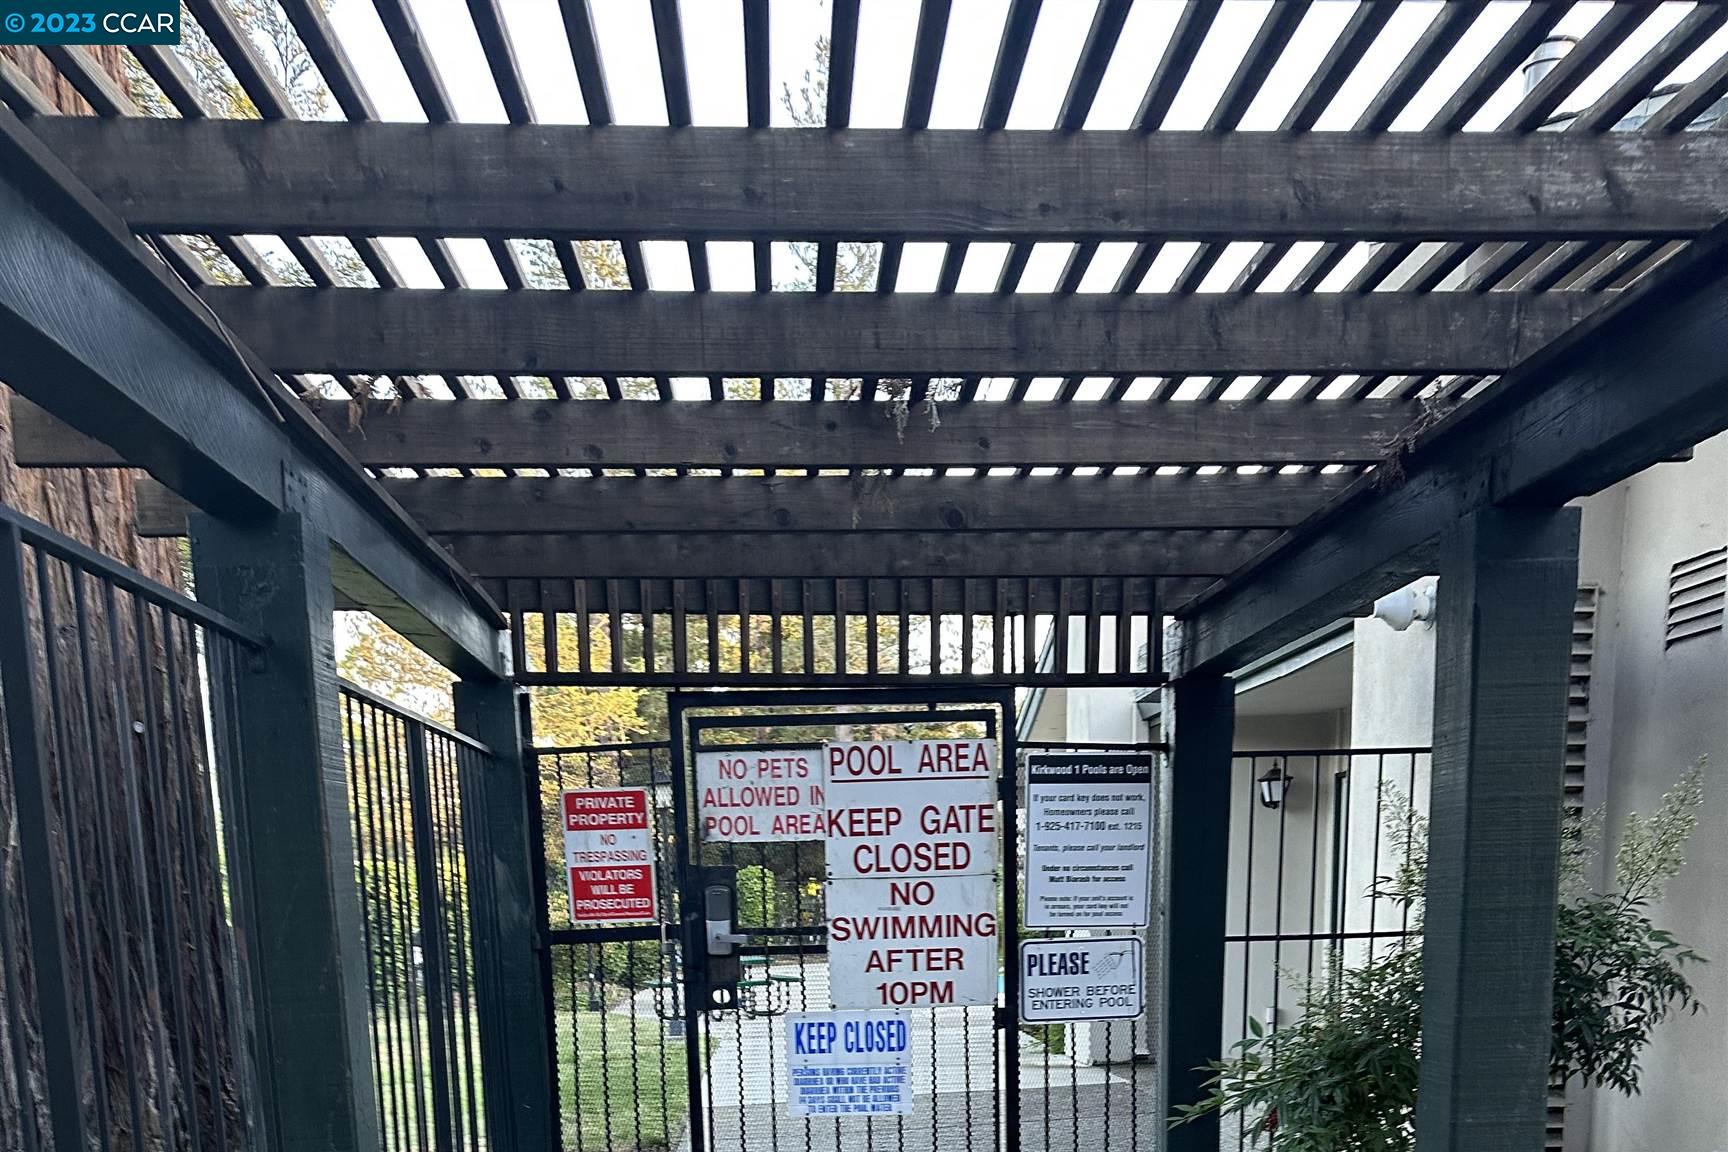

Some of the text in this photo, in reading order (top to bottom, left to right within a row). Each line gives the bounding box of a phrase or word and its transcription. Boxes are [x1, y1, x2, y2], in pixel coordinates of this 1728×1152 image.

[718, 757, 809, 780] NO PETS
[830, 743, 989, 776] POOL AREA
[1031, 763, 1149, 776] Kirkwood 1 Pools are Open
[575, 796, 635, 809] PRIVATE
[703, 785, 800, 808] ALLOWED
[1040, 795, 1056, 803] your
[569, 812, 644, 826] PROPERTY
[705, 813, 826, 837] POOL AREA
[827, 804, 995, 838] KEEP GATE
[600, 834, 616, 846] NO
[573, 850, 647, 863] TRESPASSING
[853, 842, 971, 874] CLOSED
[578, 869, 643, 881] VIOLATORS
[590, 884, 635, 895] WILL BE
[890, 881, 934, 906] NO
[576, 897, 650, 910] PROSECUTED
[831, 913, 996, 942] SWIMMING
[865, 947, 964, 973] AFTER
[1027, 952, 1089, 977] PLEASE
[876, 981, 954, 1005] 10PM
[1028, 984, 1136, 998] SHOWER BEFORE
[1031, 997, 1133, 1011] ENTERING POOL
[793, 1019, 906, 1055] KEEP CLOSED
